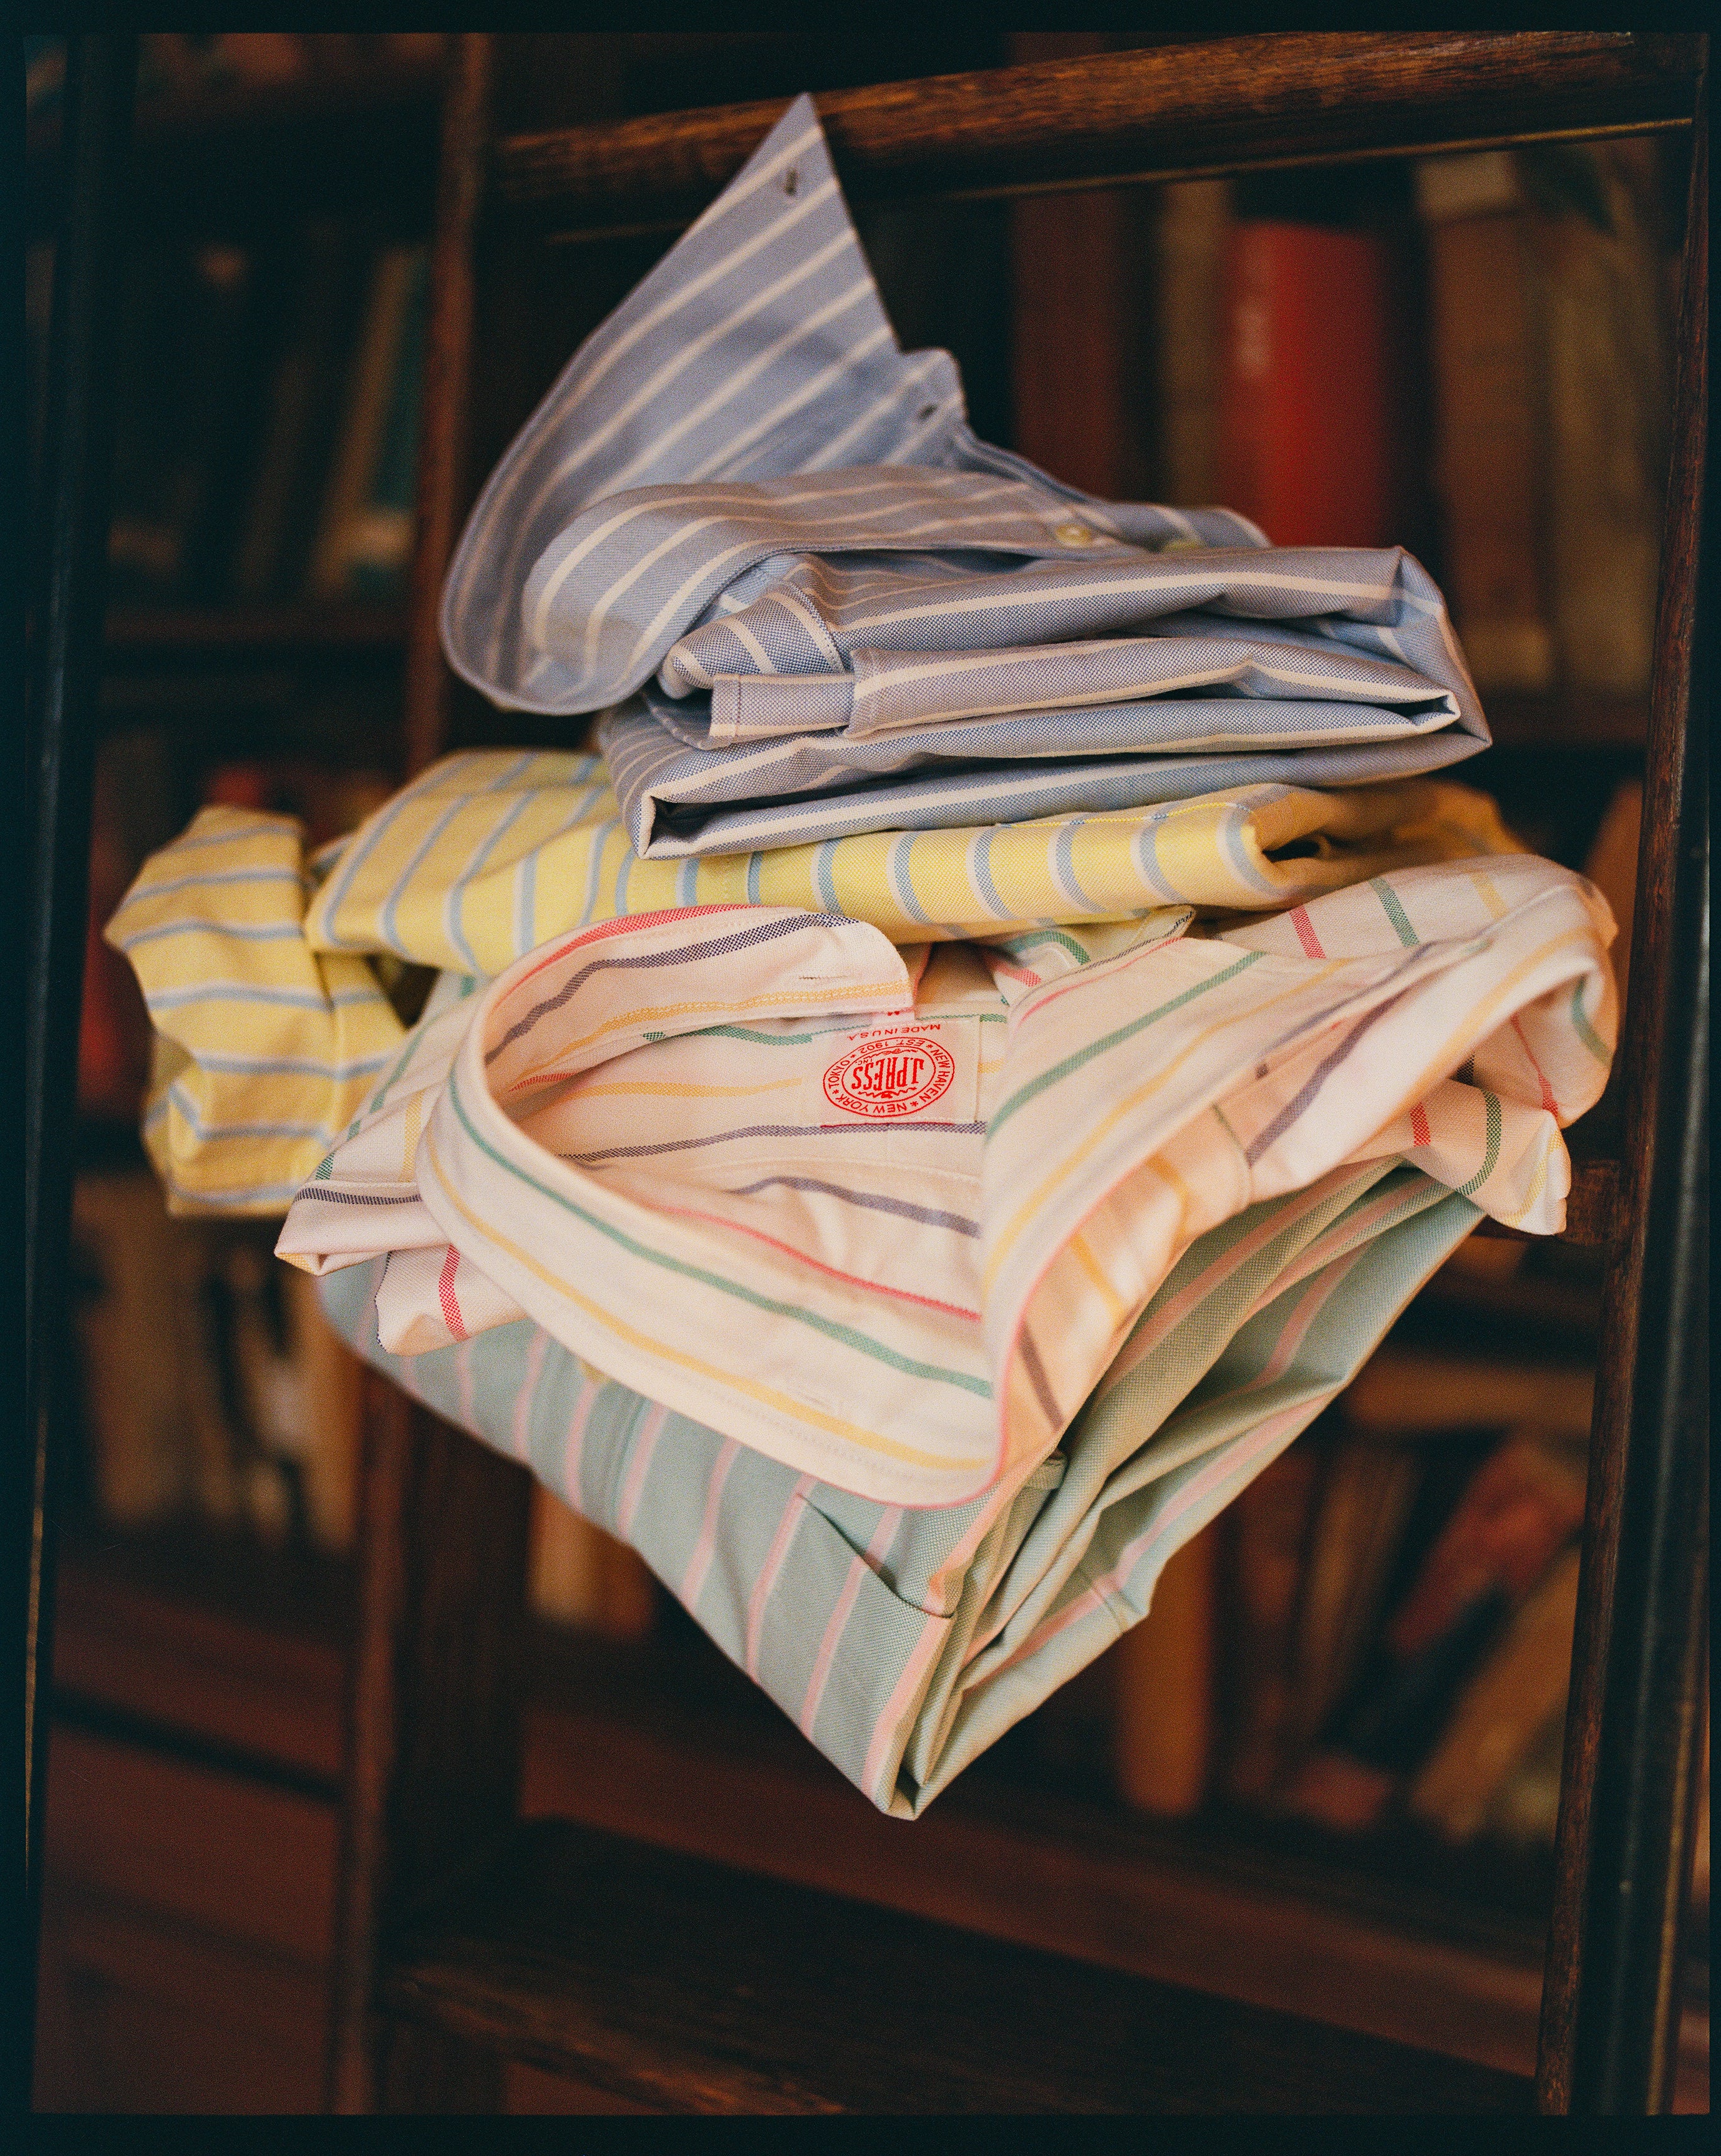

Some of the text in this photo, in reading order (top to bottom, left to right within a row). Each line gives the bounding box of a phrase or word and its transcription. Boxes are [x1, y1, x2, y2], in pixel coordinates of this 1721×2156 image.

[901, 1024, 941, 1033] MADE
[858, 1041, 888, 1053] 1902
[828, 1060, 850, 1089] TOKYO
[919, 1049, 951, 1102] NEW HAVEN
[835, 1094, 907, 1114] NEW YORK
